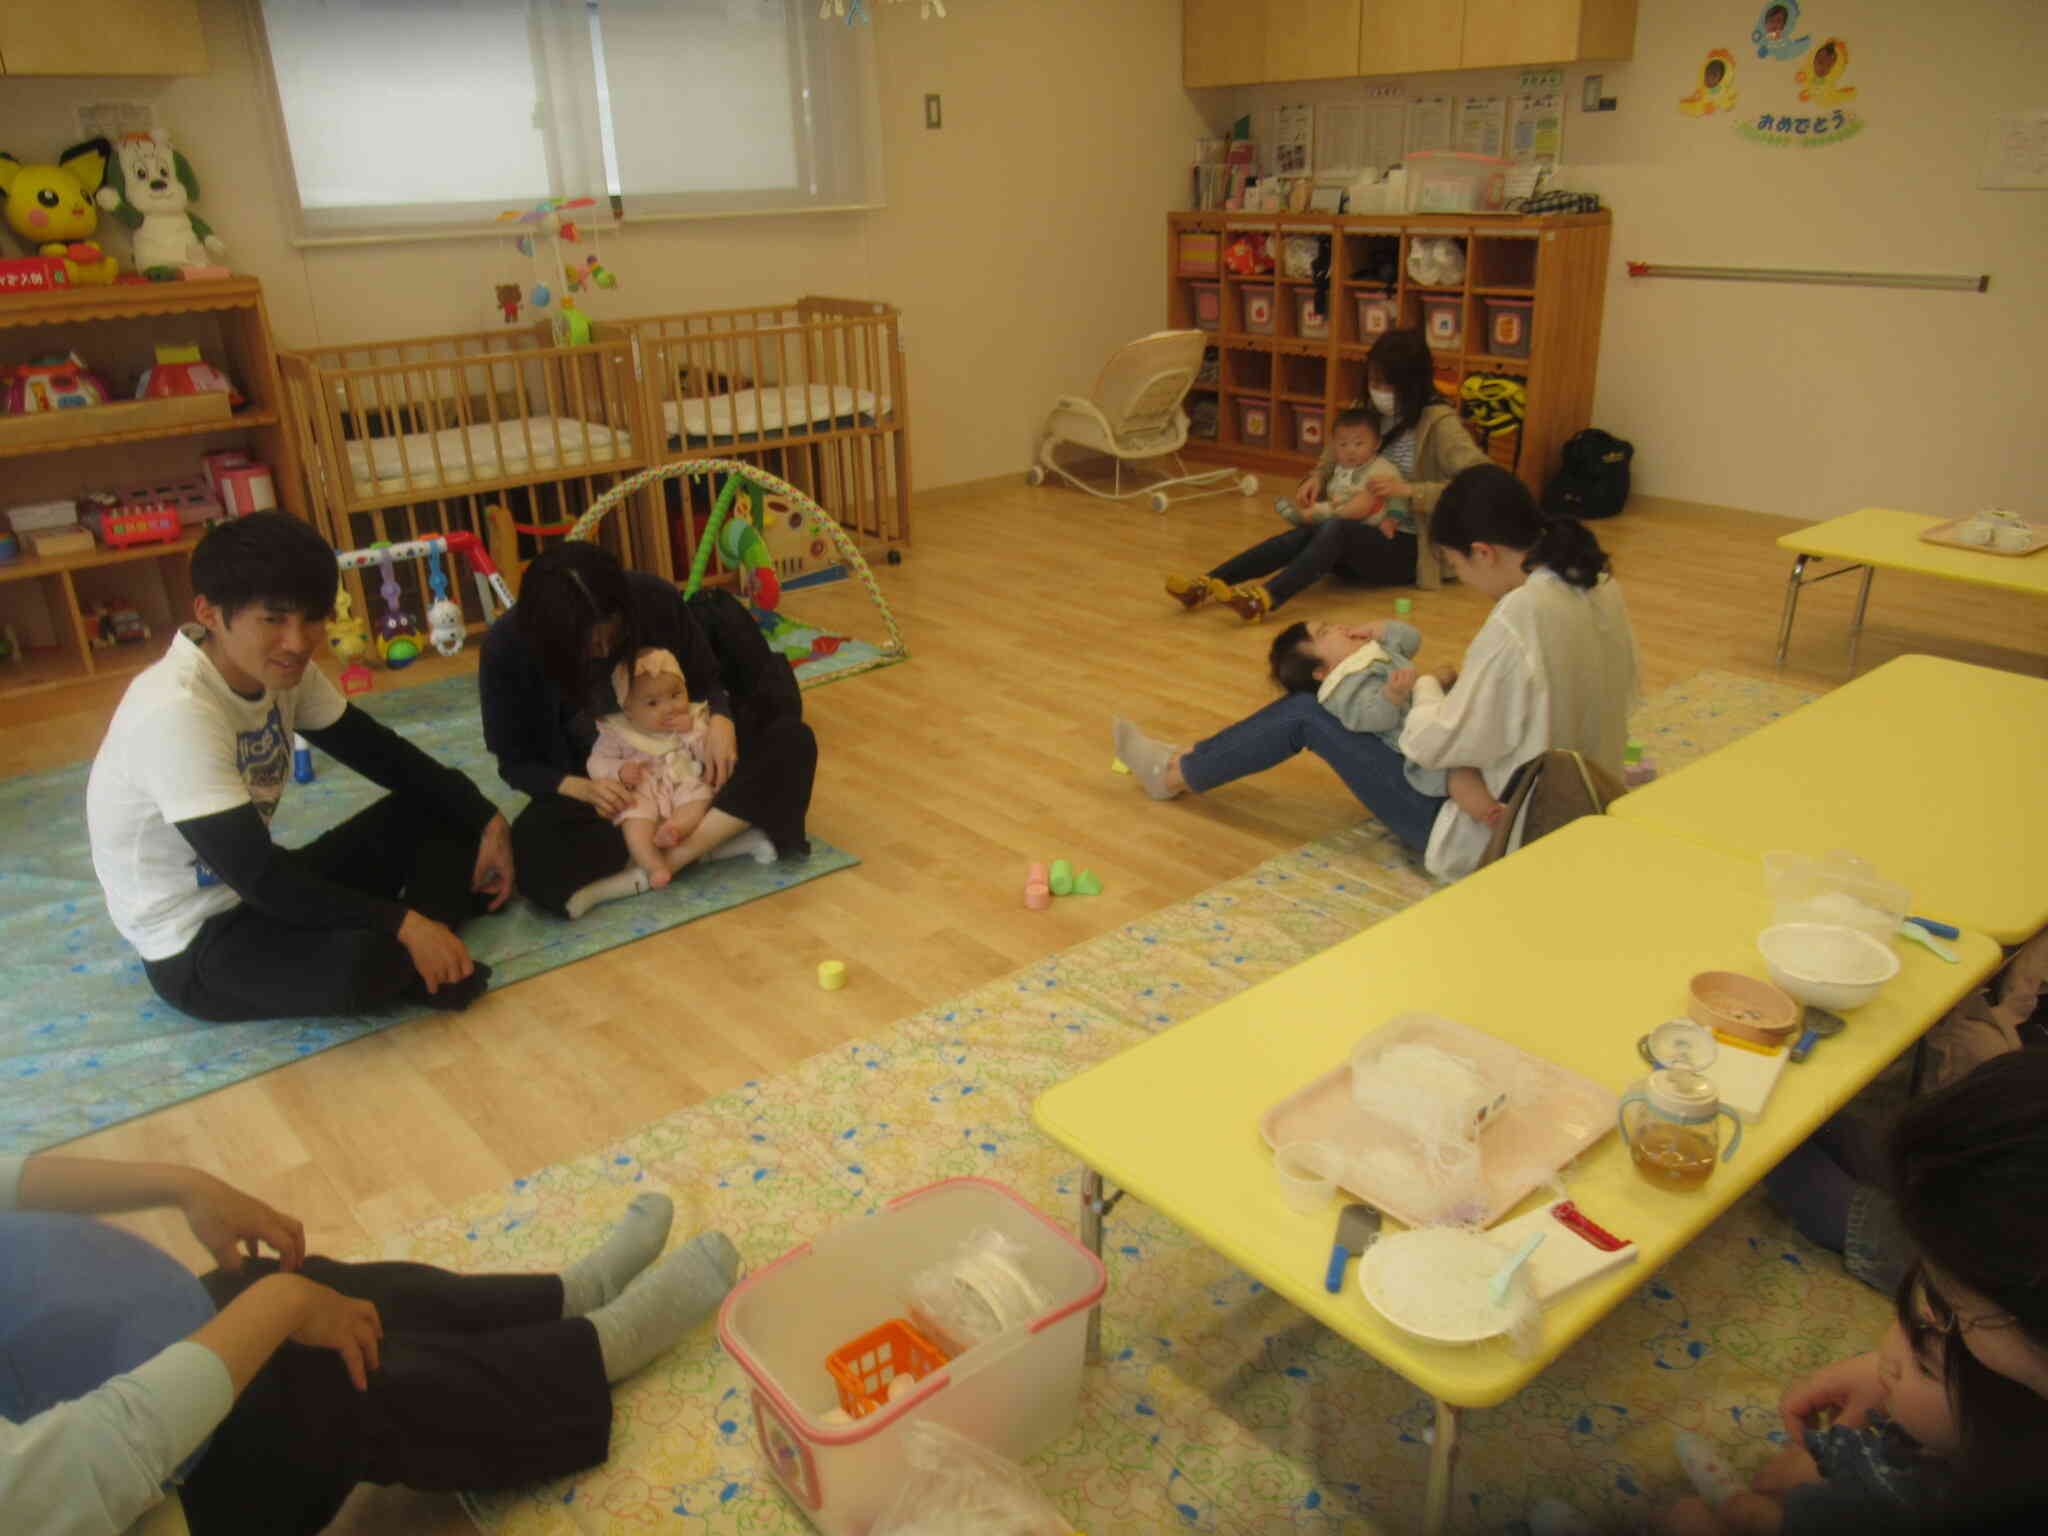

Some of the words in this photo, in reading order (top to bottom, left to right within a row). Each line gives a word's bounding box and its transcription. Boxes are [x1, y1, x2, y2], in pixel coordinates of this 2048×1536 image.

[1757, 109, 1845, 134] おめでとう
